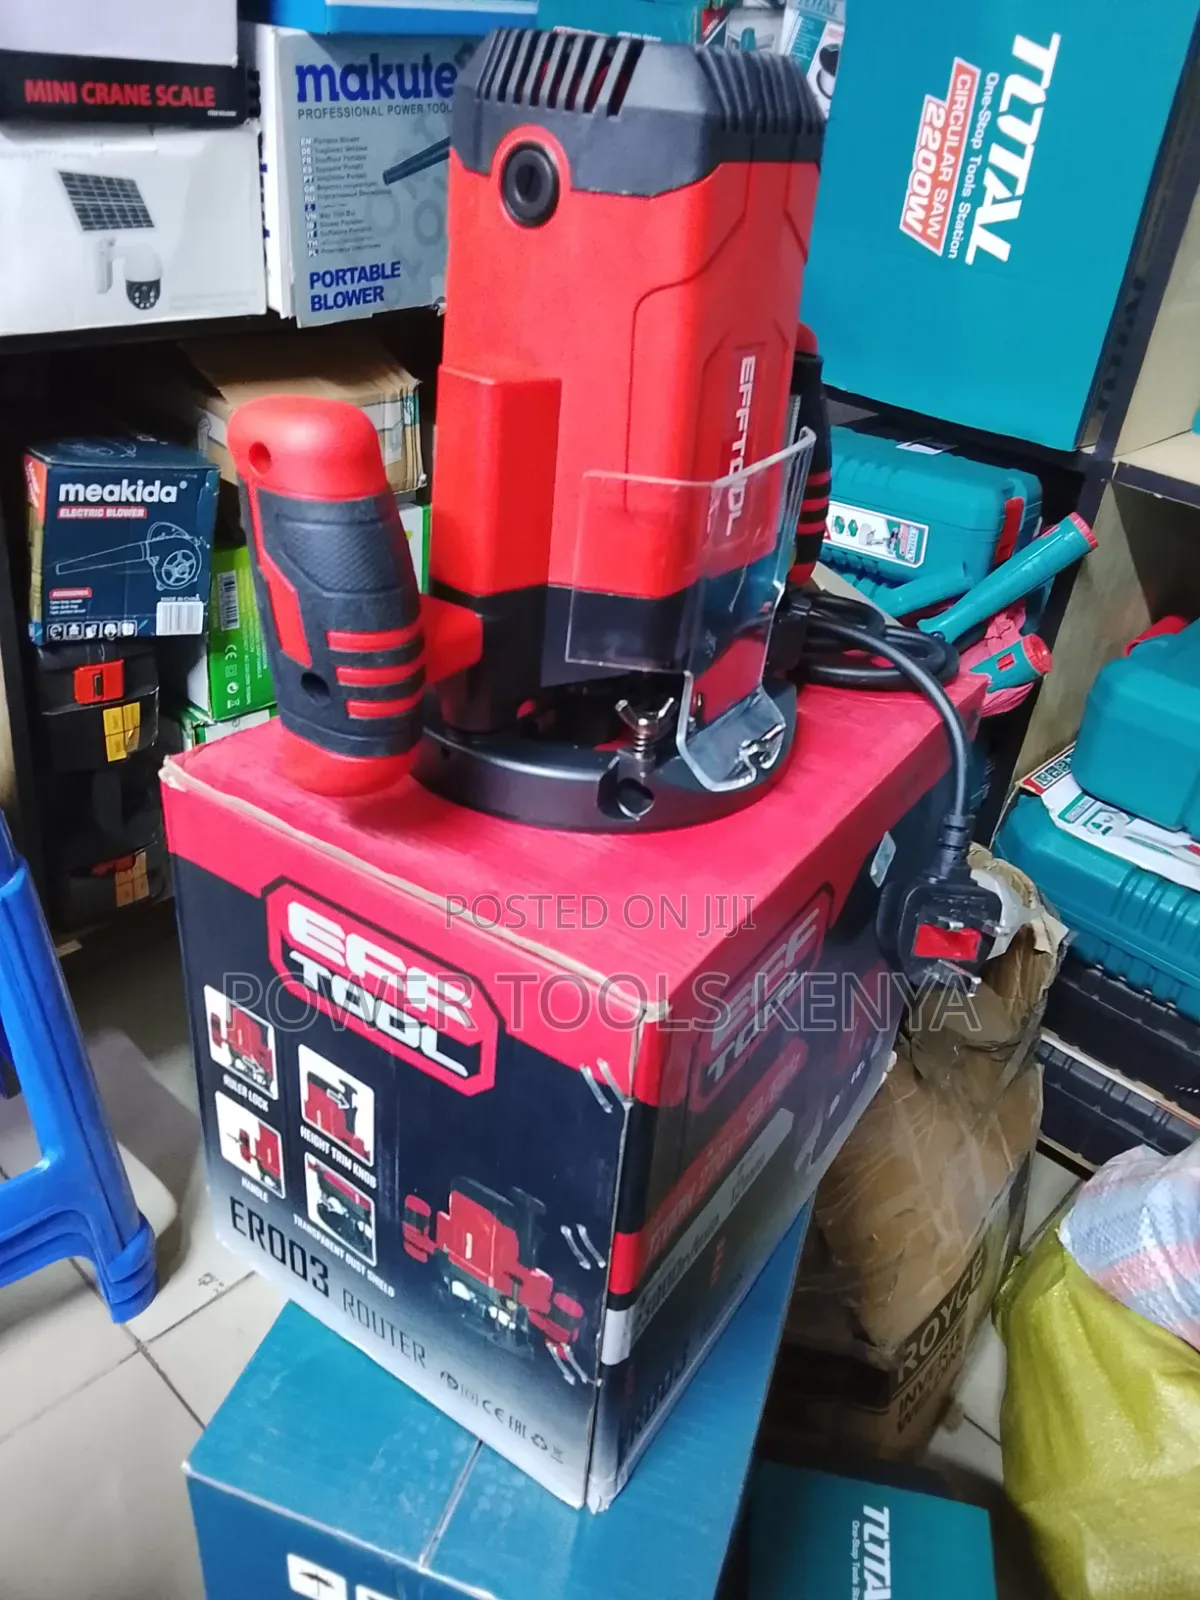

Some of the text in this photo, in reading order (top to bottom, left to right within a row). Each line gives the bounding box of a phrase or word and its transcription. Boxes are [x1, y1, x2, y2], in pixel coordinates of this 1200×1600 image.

[24, 79, 216, 108] MINI CRANE SCALE
[295, 53, 458, 103] makute
[298, 104, 384, 120] PROFESSIONAL
[387, 103, 424, 116] POWER
[905, 102, 948, 234] 2200W
[926, 74, 972, 240] CIRCULAR SAW
[948, 72, 999, 260] One-Stop Tools Station
[965, 32, 1061, 265] TOTAL
[309, 261, 401, 290] PORTABLE
[311, 285, 384, 313] BLOWER
[58, 478, 178, 503] meakida
[59, 507, 145, 518] ELECTRIC BLOWER
[289, 950, 469, 1078] TOOL
[223, 1074, 269, 1112] RULER LOCK
[300, 1125, 377, 1189] HEIGHT TRIM KNOB
[241, 1177, 269, 1204] HANDLE
[230, 1195, 329, 1299] ER003
[293, 1213, 395, 1299] TRANSPARENT DUST SHIELD
[342, 1287, 426, 1370] ROUTER
[898, 1247, 985, 1384] ROYCE
